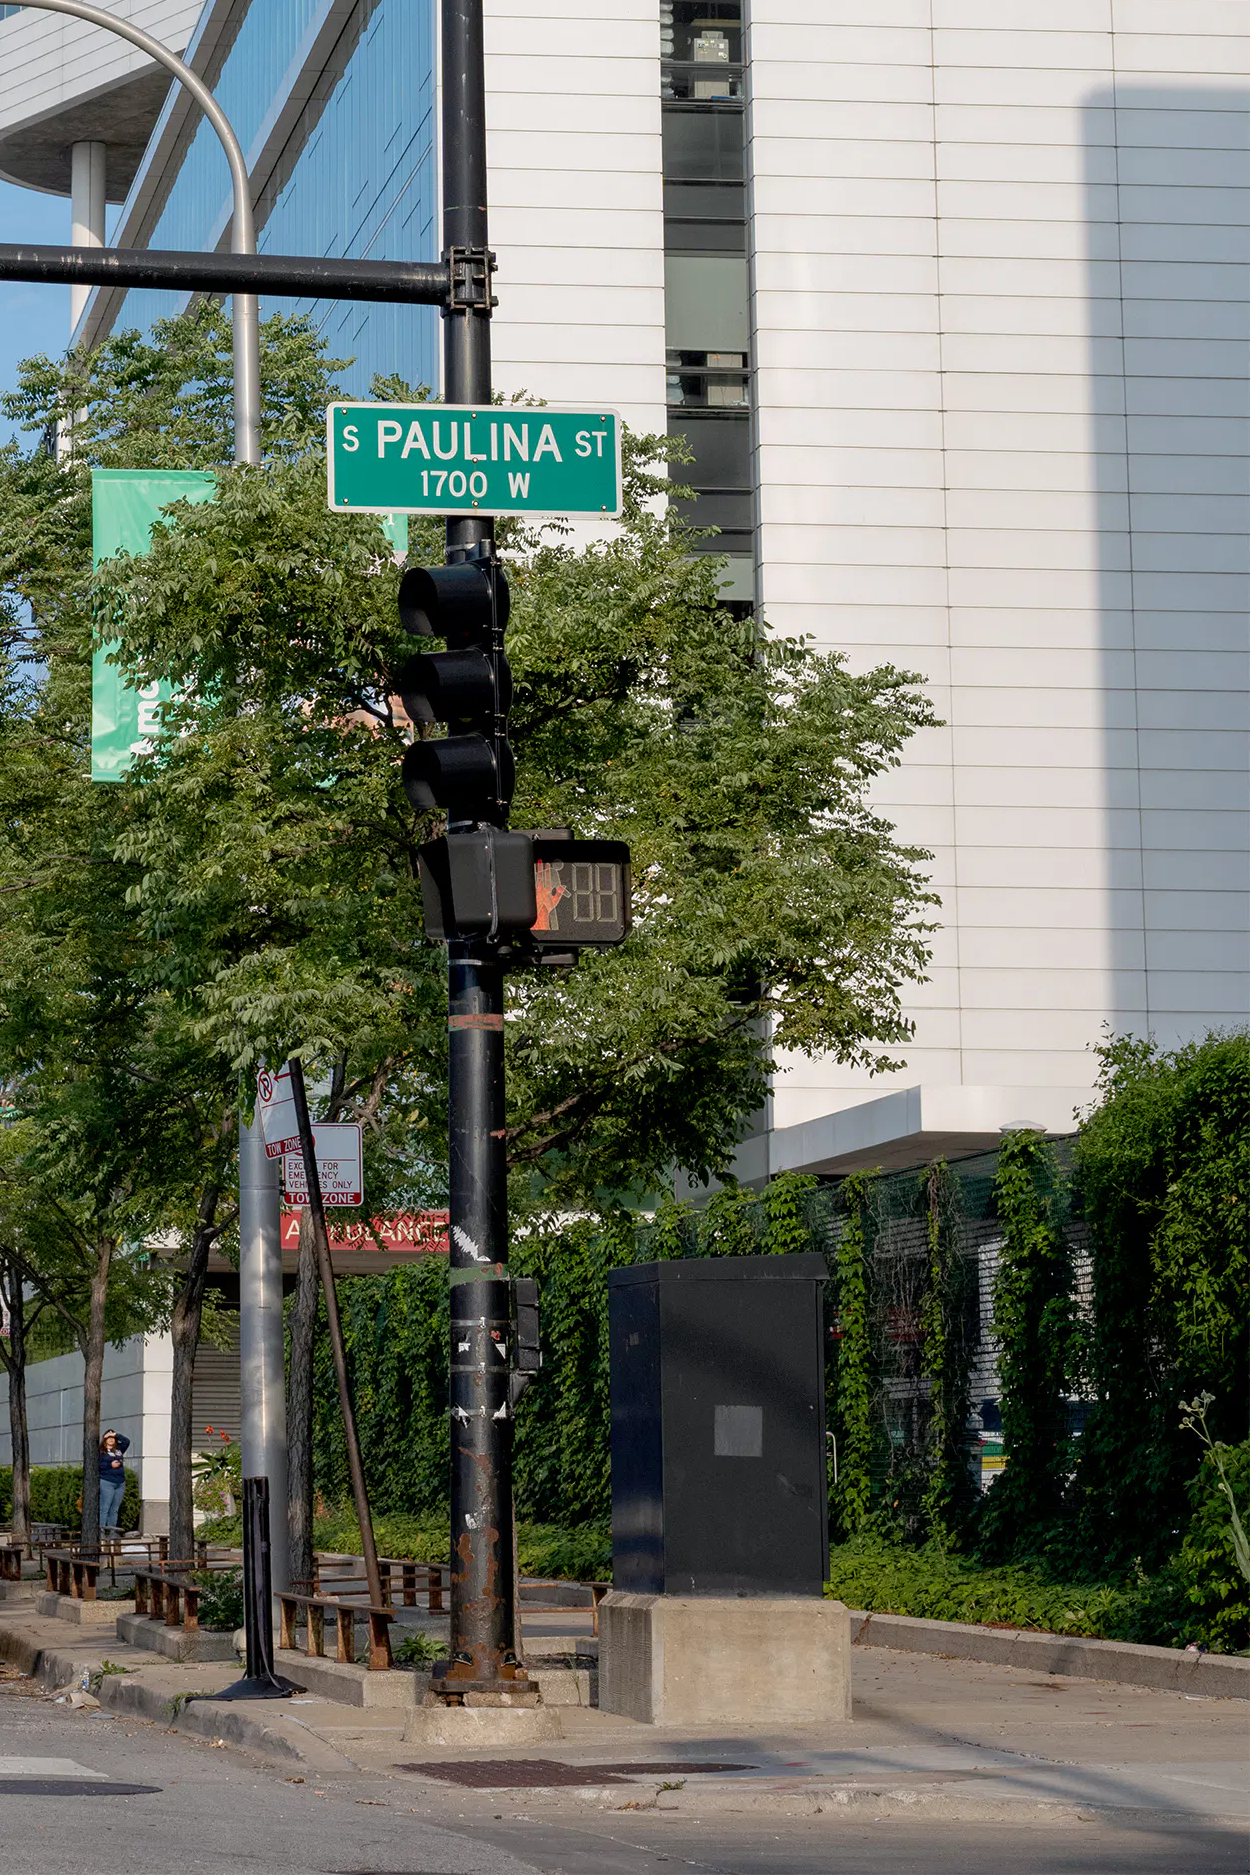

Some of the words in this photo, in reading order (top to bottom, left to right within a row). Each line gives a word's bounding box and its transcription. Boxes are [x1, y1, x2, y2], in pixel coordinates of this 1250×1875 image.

[342, 425, 360, 452] S
[377, 420, 563, 463] PAULINA
[574, 431, 607, 457] ST
[420, 470, 488, 498] 1700
[507, 472, 531, 499] W
[267, 1142, 282, 1156] TOW
[283, 1136, 302, 1152] ZONE
[323, 1162, 339, 1170] FOR
[288, 1172, 339, 1180] EMEENCY
[332, 1181, 353, 1189] ONLY
[321, 1193, 355, 1204] ZONE
